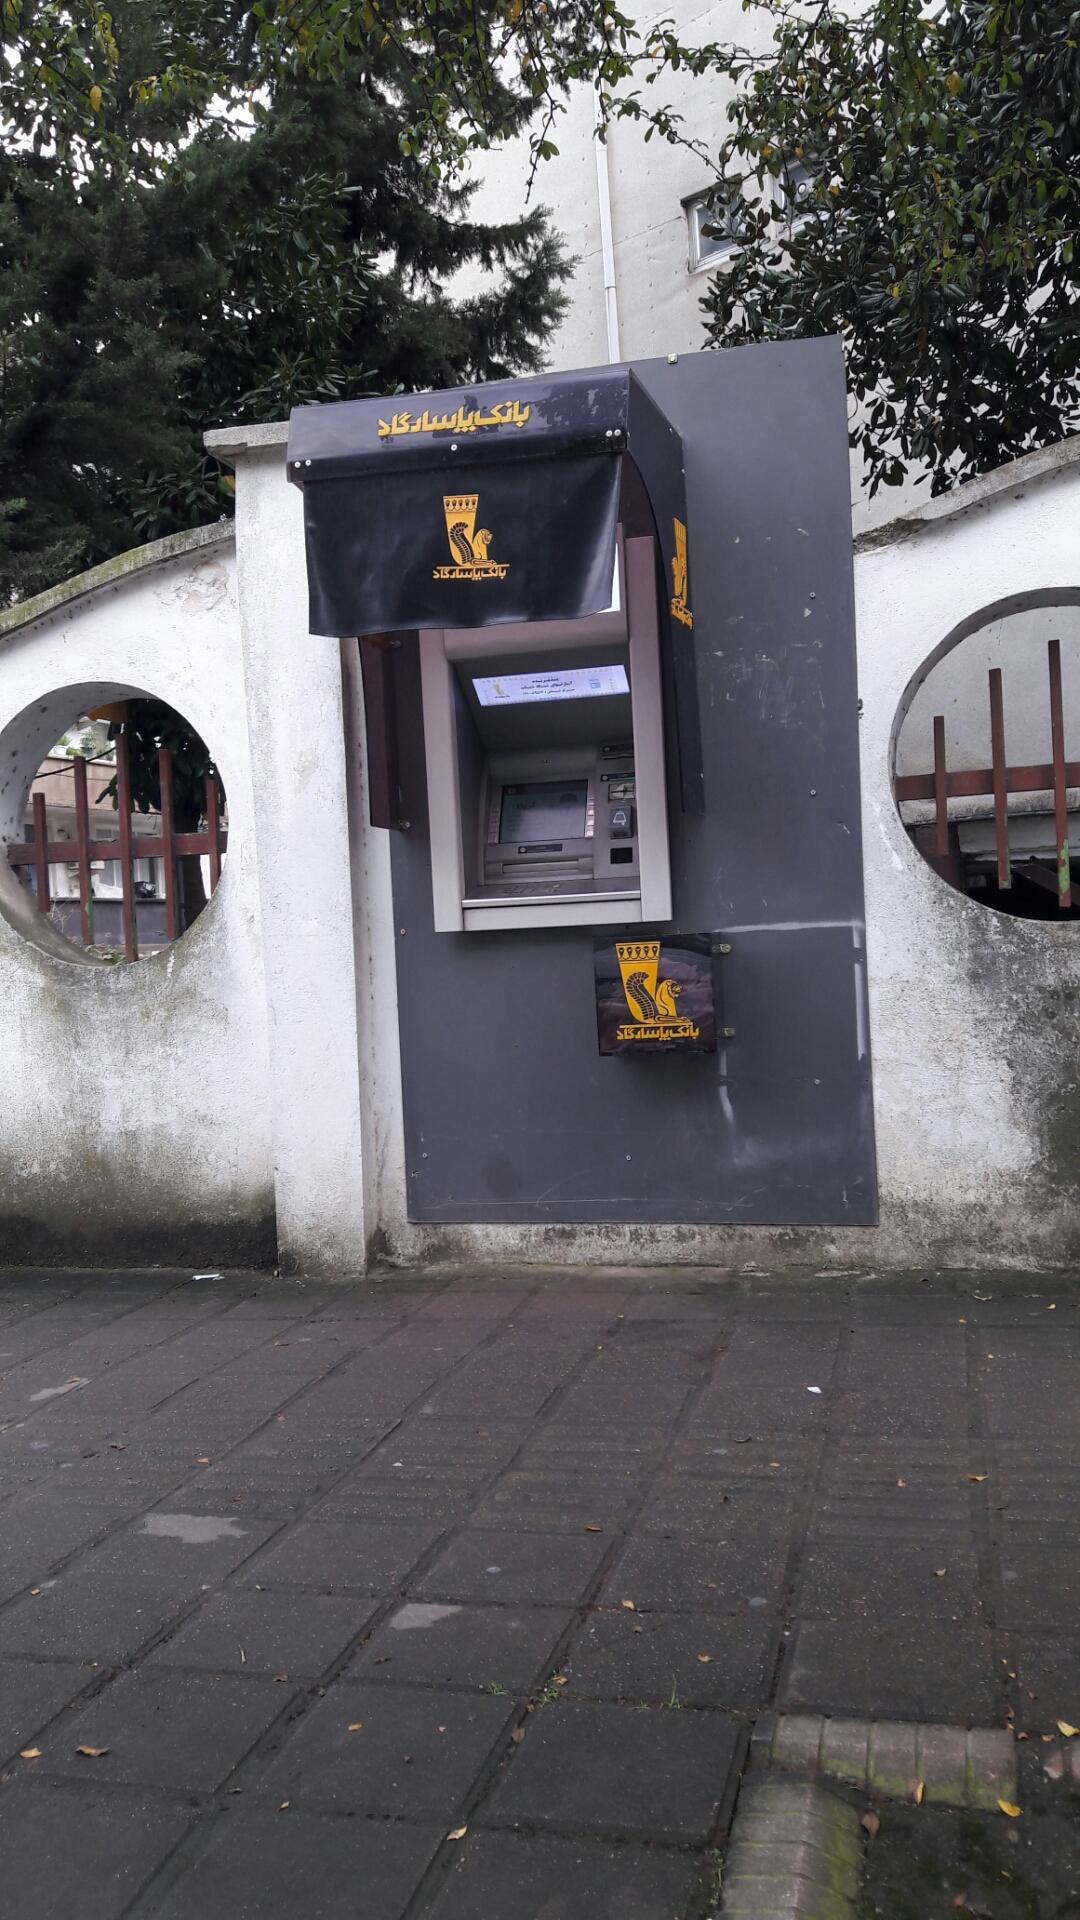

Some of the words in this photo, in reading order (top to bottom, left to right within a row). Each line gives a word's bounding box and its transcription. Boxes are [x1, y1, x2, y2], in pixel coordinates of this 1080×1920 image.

[475, 399, 530, 428] بانک
[377, 406, 475, 437] پاسارگاد
[432, 567, 481, 581] پاسارگاد
[481, 567, 507, 580] بانک
[616, 1026, 671, 1041] پاسارگاد
[671, 1024, 700, 1040] بانک
